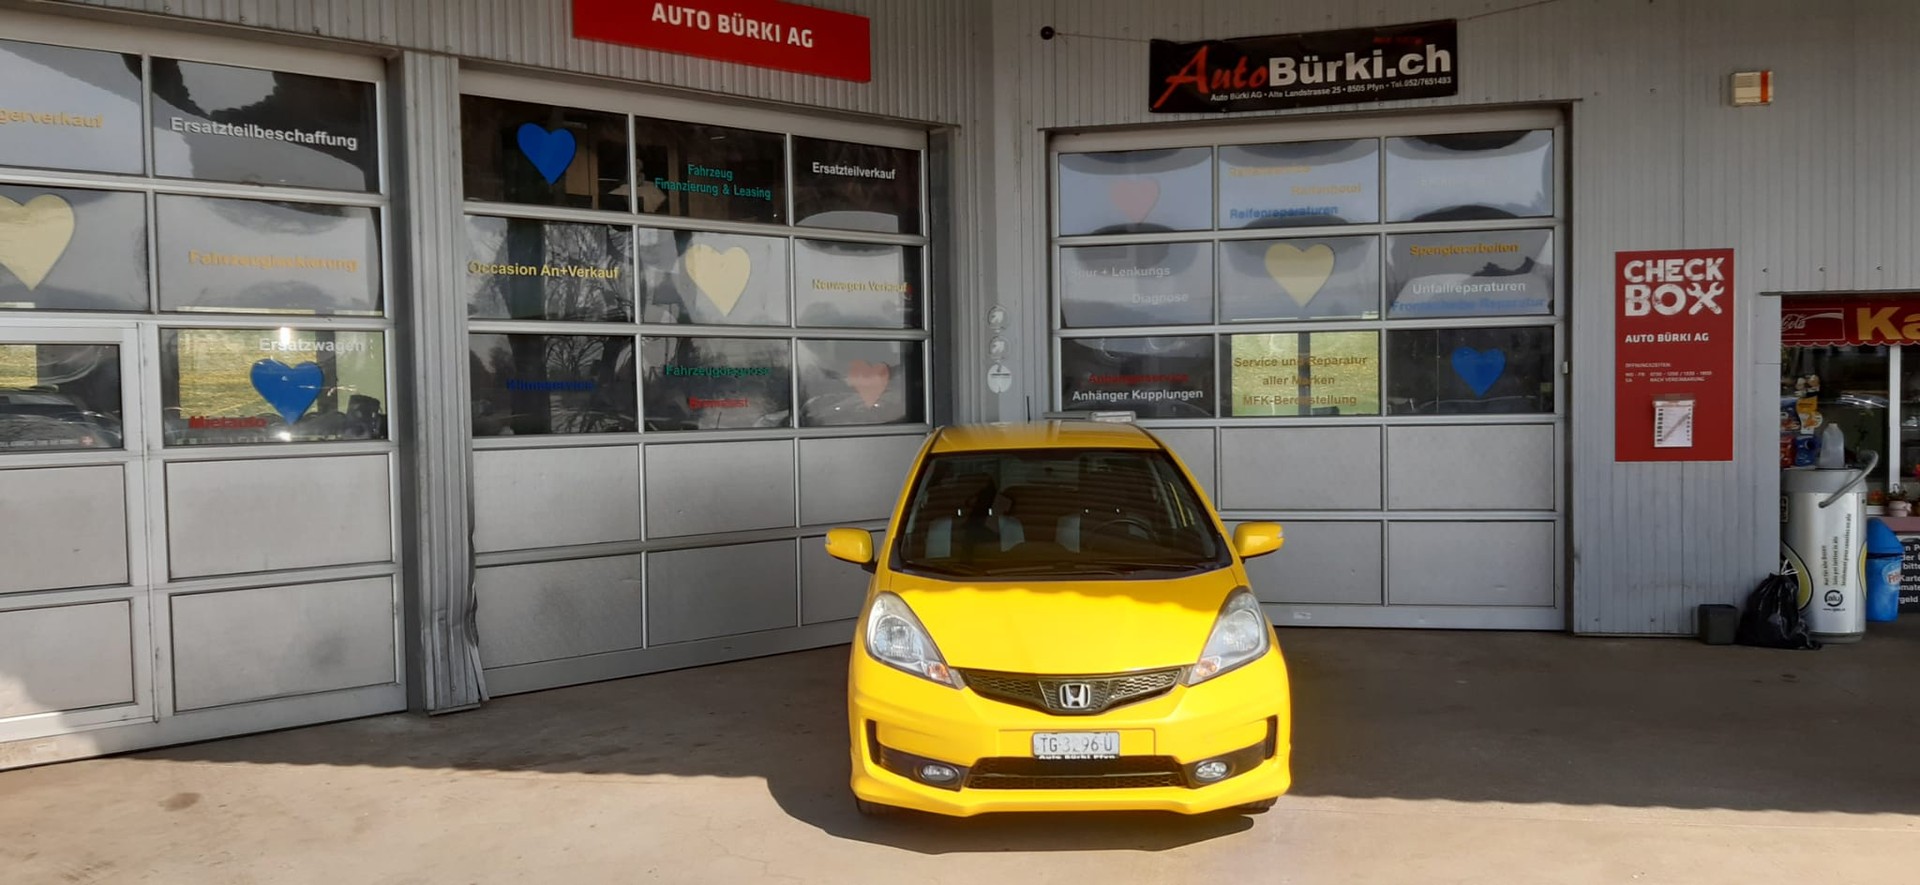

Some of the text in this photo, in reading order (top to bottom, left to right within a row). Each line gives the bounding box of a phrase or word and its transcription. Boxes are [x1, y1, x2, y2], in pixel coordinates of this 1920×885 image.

[651, 3, 813, 48] AUTO BÜRKI AG
[1211, 92, 1228, 101] Auto
[1250, 91, 1263, 99] AG
[1285, 88, 1331, 97] Landstrasse
[1332, 86, 1341, 94] 25
[1367, 83, 1384, 92] Pfyn
[170, 116, 358, 151] Ersatzteilbeschaffung
[688, 164, 734, 182] Fahrzeug
[812, 162, 896, 181] Ersatzteilverkauf
[655, 177, 772, 200] Finanzierung & Leasing
[468, 262, 620, 280] Occasion An+Verkauf
[1111, 265, 1171, 278] Lenkungs
[1624, 258, 1724, 283] CHECK
[1412, 281, 1526, 296] Unfallreparaturen
[1624, 282, 1724, 317] BOX
[1625, 332, 1710, 344] AUTO BÜRKI AG
[1234, 357, 1278, 367] Service
[1308, 355, 1368, 368] Reparatur
[1262, 378, 1289, 386] aller
[1072, 387, 1204, 402] Anhänger Kupplungen
[1041, 738, 1058, 753] TG
